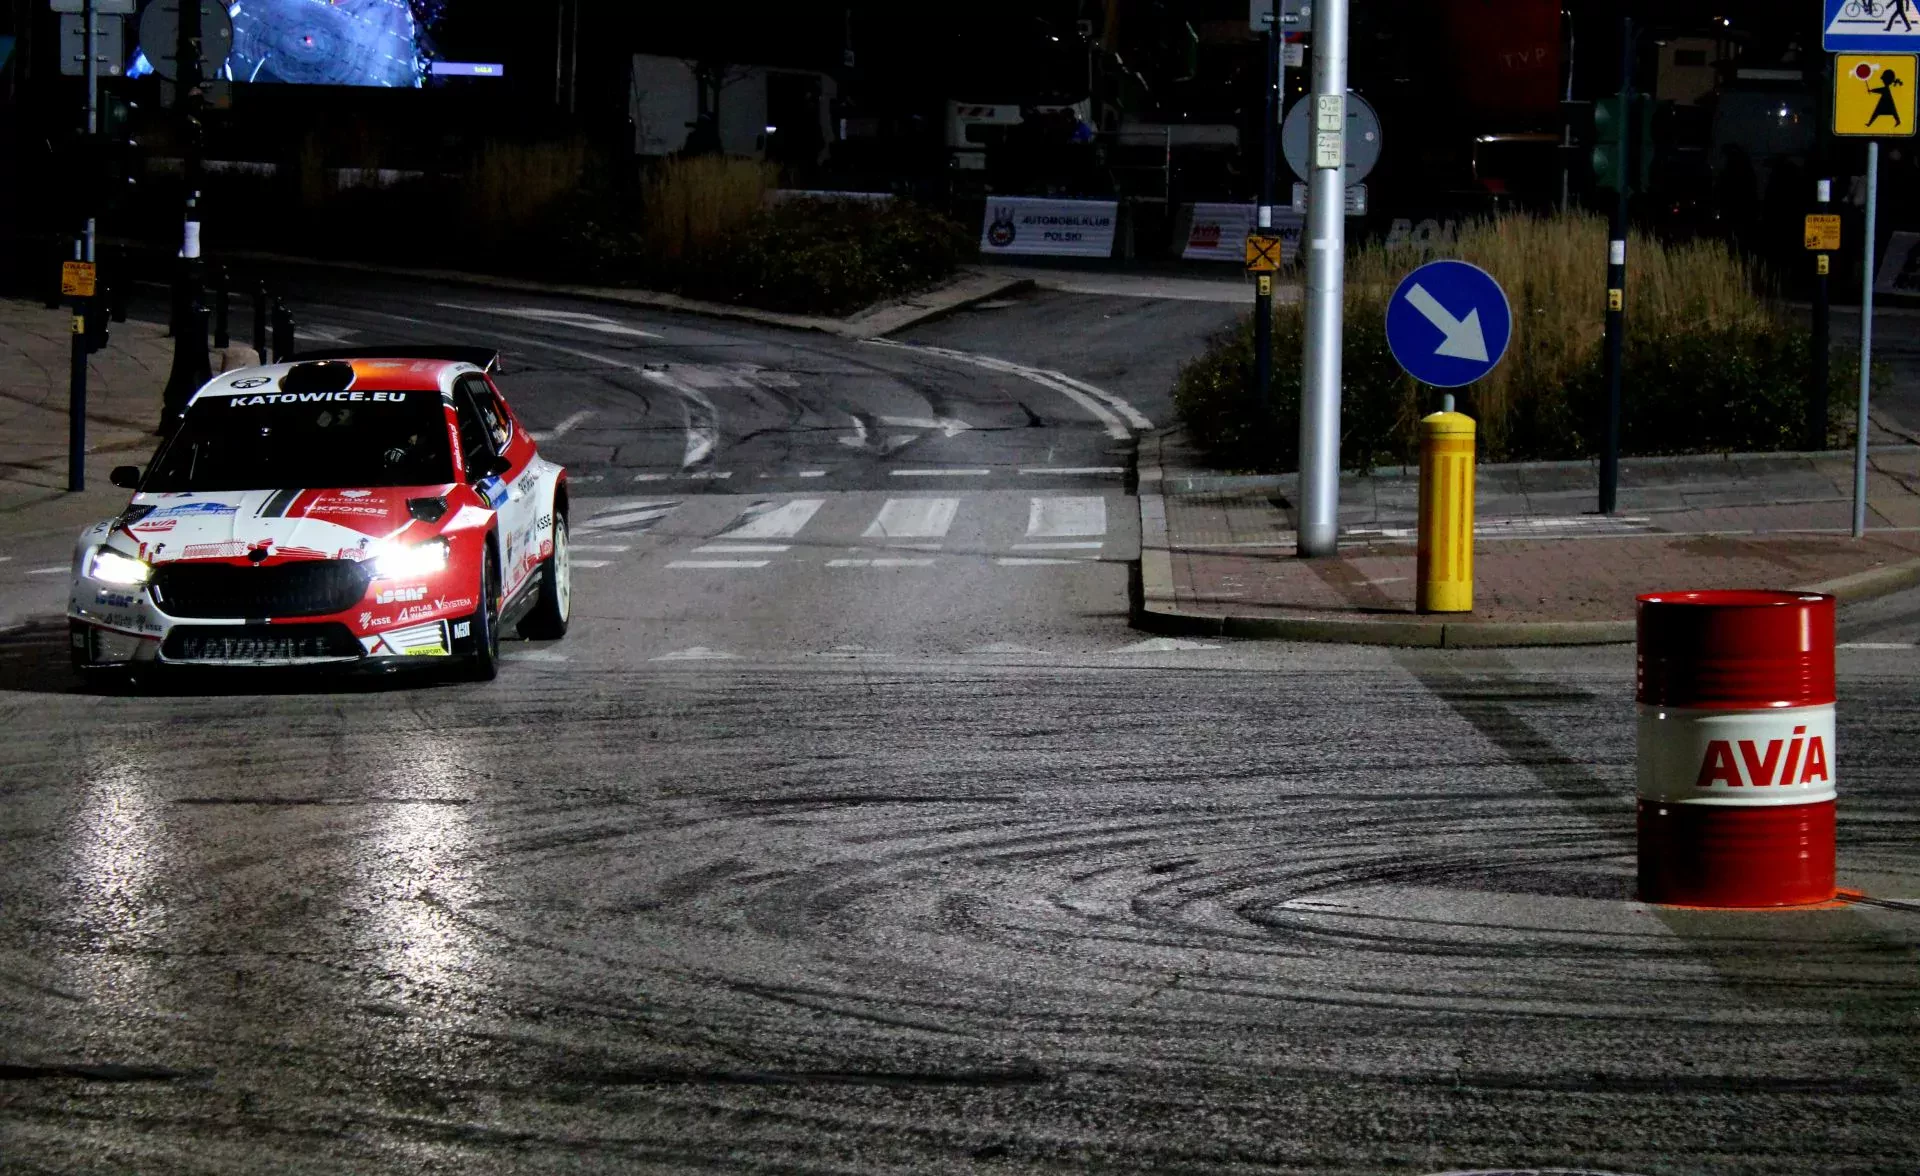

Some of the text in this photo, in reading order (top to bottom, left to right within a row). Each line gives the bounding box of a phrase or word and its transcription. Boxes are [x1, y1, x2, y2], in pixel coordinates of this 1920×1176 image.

[1023, 216, 1110, 226] AUTOMOBILKLUB
[1044, 232, 1082, 241] POLSKI
[230, 392, 406, 407] KATOWICE.EU
[139, 519, 178, 528] AVIA
[409, 604, 433, 613] ATLAS
[371, 617, 392, 626] KSSE
